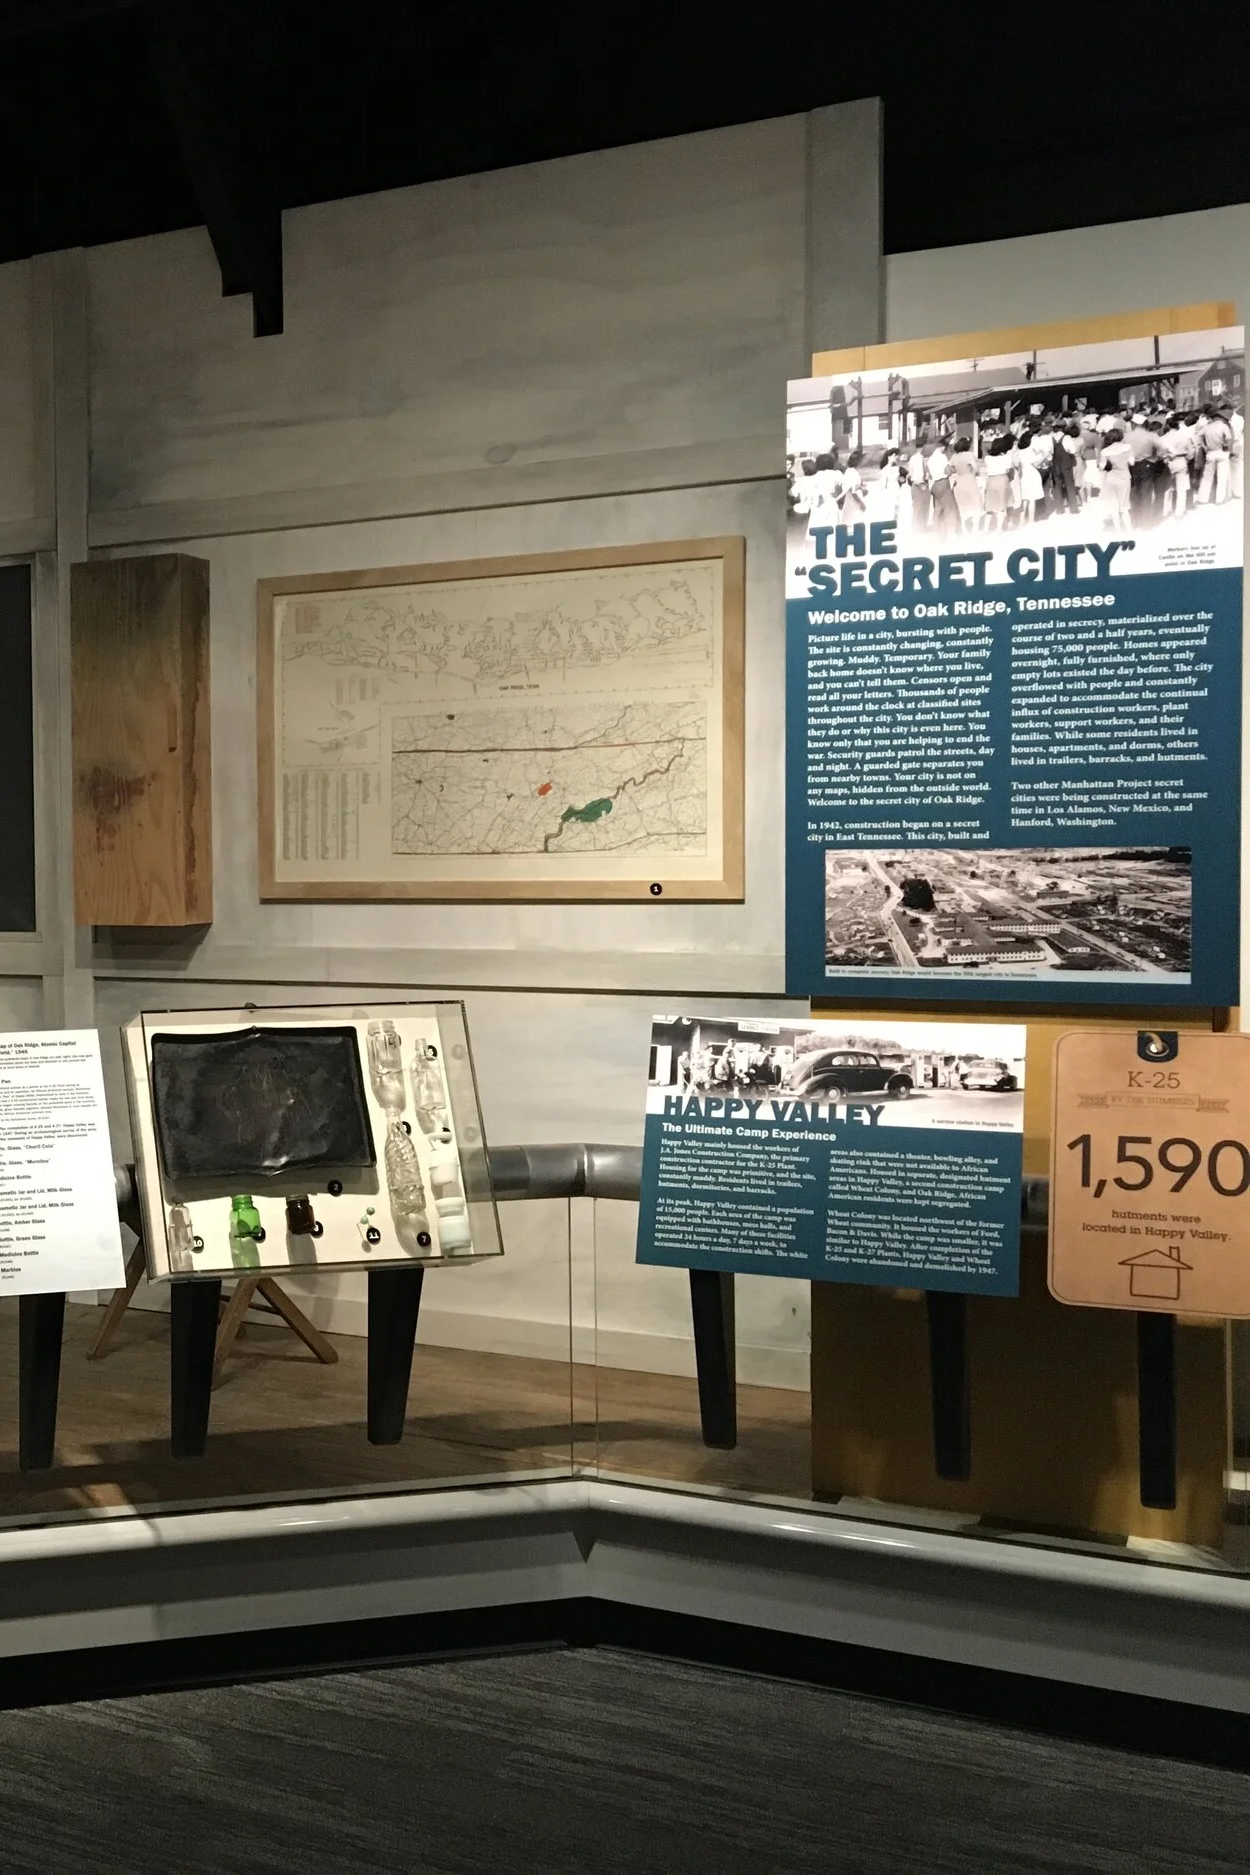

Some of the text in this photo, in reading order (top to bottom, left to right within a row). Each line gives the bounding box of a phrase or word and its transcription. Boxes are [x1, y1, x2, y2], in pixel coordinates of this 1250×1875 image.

[809, 520, 897, 560] THE
[808, 594, 1116, 625] Welcome to Oak Ridge, Tennessee
[808, 632, 840, 642] Picture
[841, 631, 856, 641] life
[857, 631, 867, 640] in
[875, 629, 895, 641] city,
[896, 627, 935, 640] bursting
[936, 626, 957, 636] with
[959, 624, 993, 637] people.
[808, 645, 824, 654] The
[825, 644, 842, 654] site
[852, 641, 898, 655] constantly
[899, 639, 944, 652] changing,
[946, 636, 994, 650] constantly
[1011, 636, 1207, 658] housing 75,000 people. Homes appeared
[807, 648, 991, 668] growing. Muddy. Temporary. Your family
[1011, 802, 1193, 816] time in Los Alamos, New Mexico, and
[808, 820, 817, 829] In
[820, 820, 843, 832] 1942,
[844, 819, 901, 829] construction
[902, 819, 930, 831] began
[953, 818, 980, 828] secret
[1011, 816, 1117, 829] Hanford, Washington.
[1127, 1071, 1181, 1089] K-25
[1127, 1096, 1144, 1104] THE
[663, 1095, 885, 1126] HAPPY VALLEY
[662, 1123, 837, 1142] The Ultimate Camp Experience
[1067, 1134, 1250, 1198] 1,590
[1111, 1210, 1201, 1223] hutments were
[1082, 1223, 1232, 1242] located in Happy Valley.
